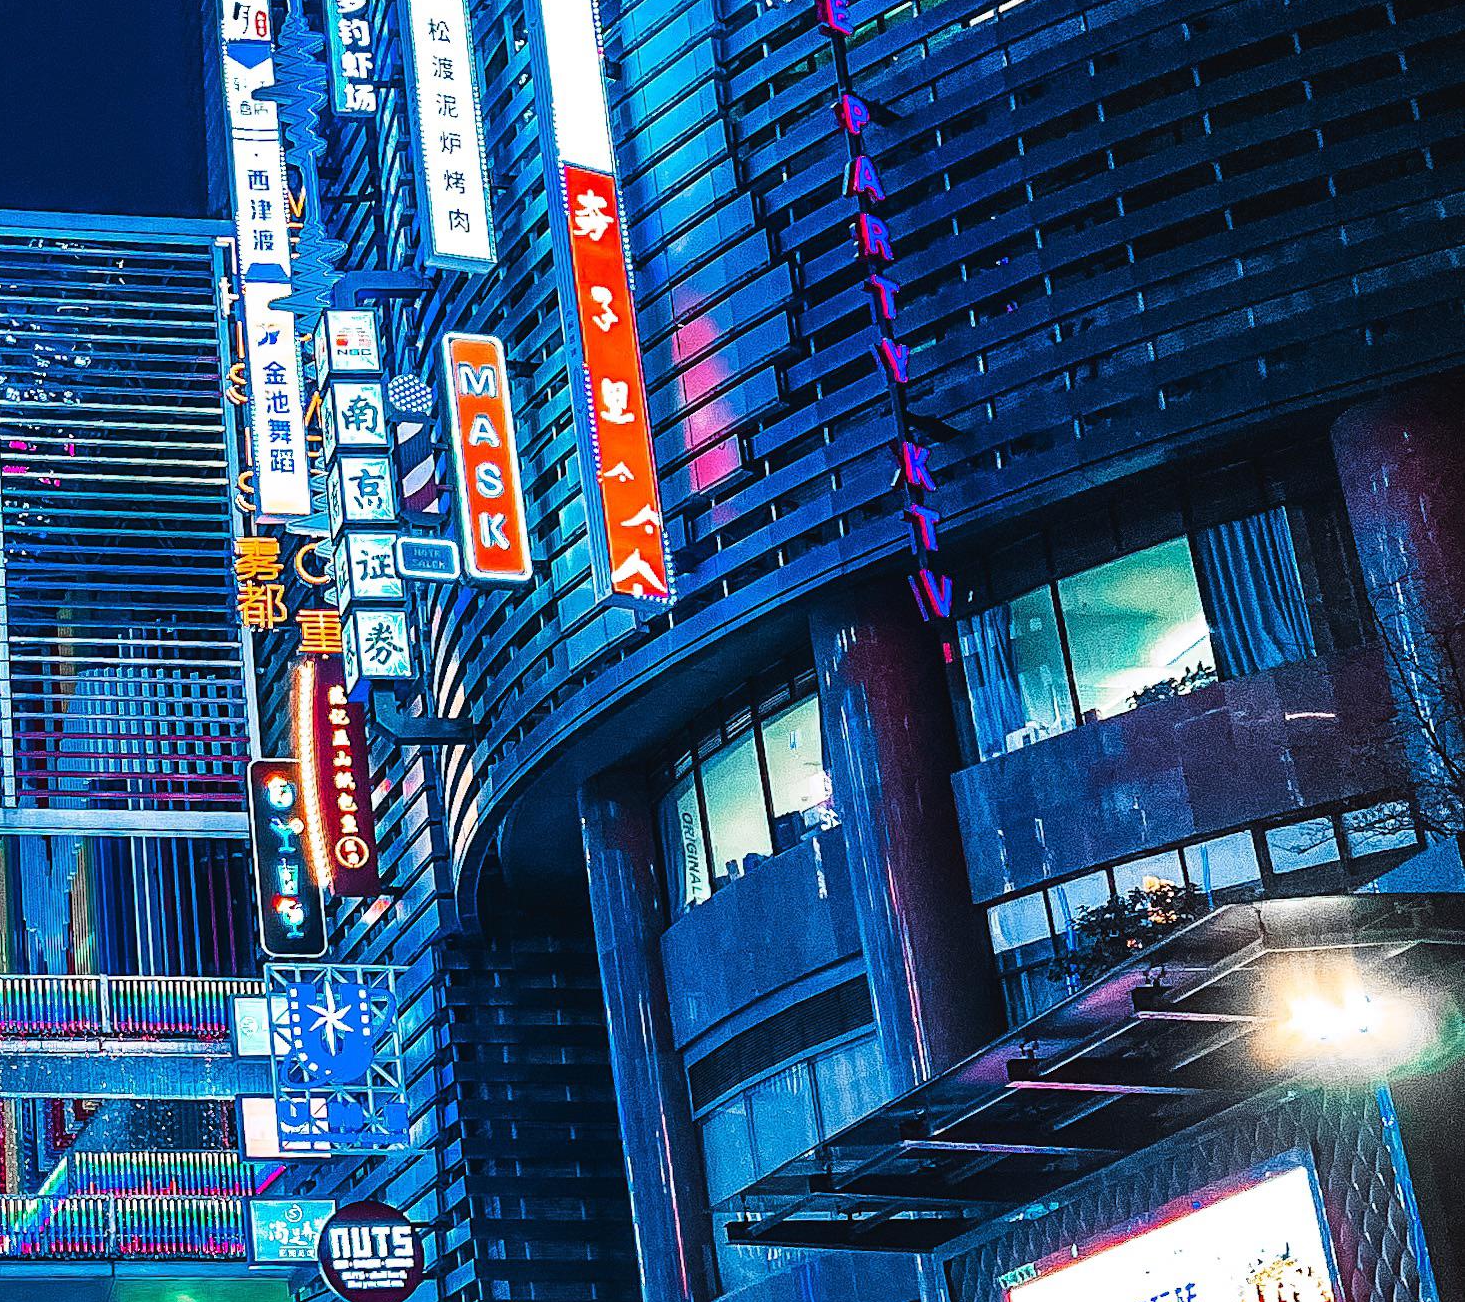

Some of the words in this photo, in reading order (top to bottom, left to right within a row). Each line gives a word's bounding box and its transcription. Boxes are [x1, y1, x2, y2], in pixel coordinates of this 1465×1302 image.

[247, 169, 275, 251] 西津渡
[427, 17, 471, 234] 松渡泥炉烤肉
[263, 361, 295, 475] 金池舞蹈
[842, 94, 911, 386] PARTY
[902, 441, 954, 620] KTV
[341, 394, 404, 666] 南京证券
[458, 361, 511, 551] MASK
[234, 537, 288, 630] 雾都
